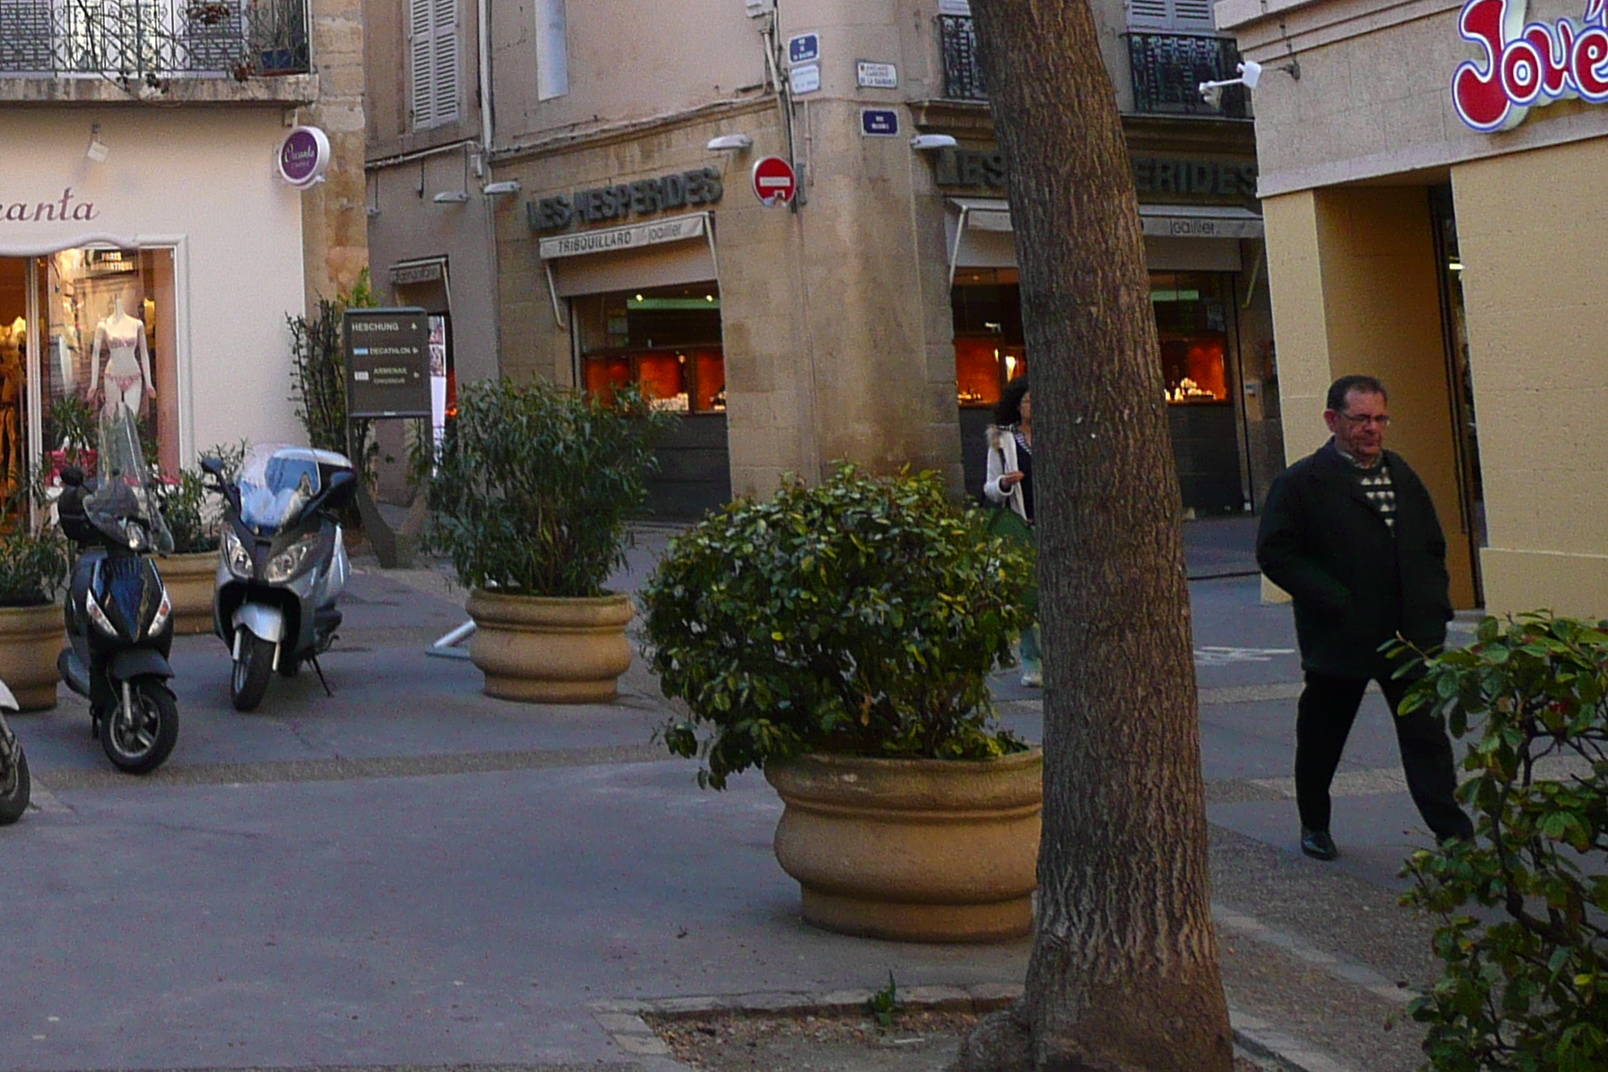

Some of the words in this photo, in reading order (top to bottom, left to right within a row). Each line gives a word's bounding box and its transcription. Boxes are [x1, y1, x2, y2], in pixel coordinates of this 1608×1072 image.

[526, 195, 572, 229] LES
[574, 167, 724, 223] HESPERIDES
[558, 232, 632, 253] TRIBOUILLARD
[352, 323, 399, 332] HESCHUNG
